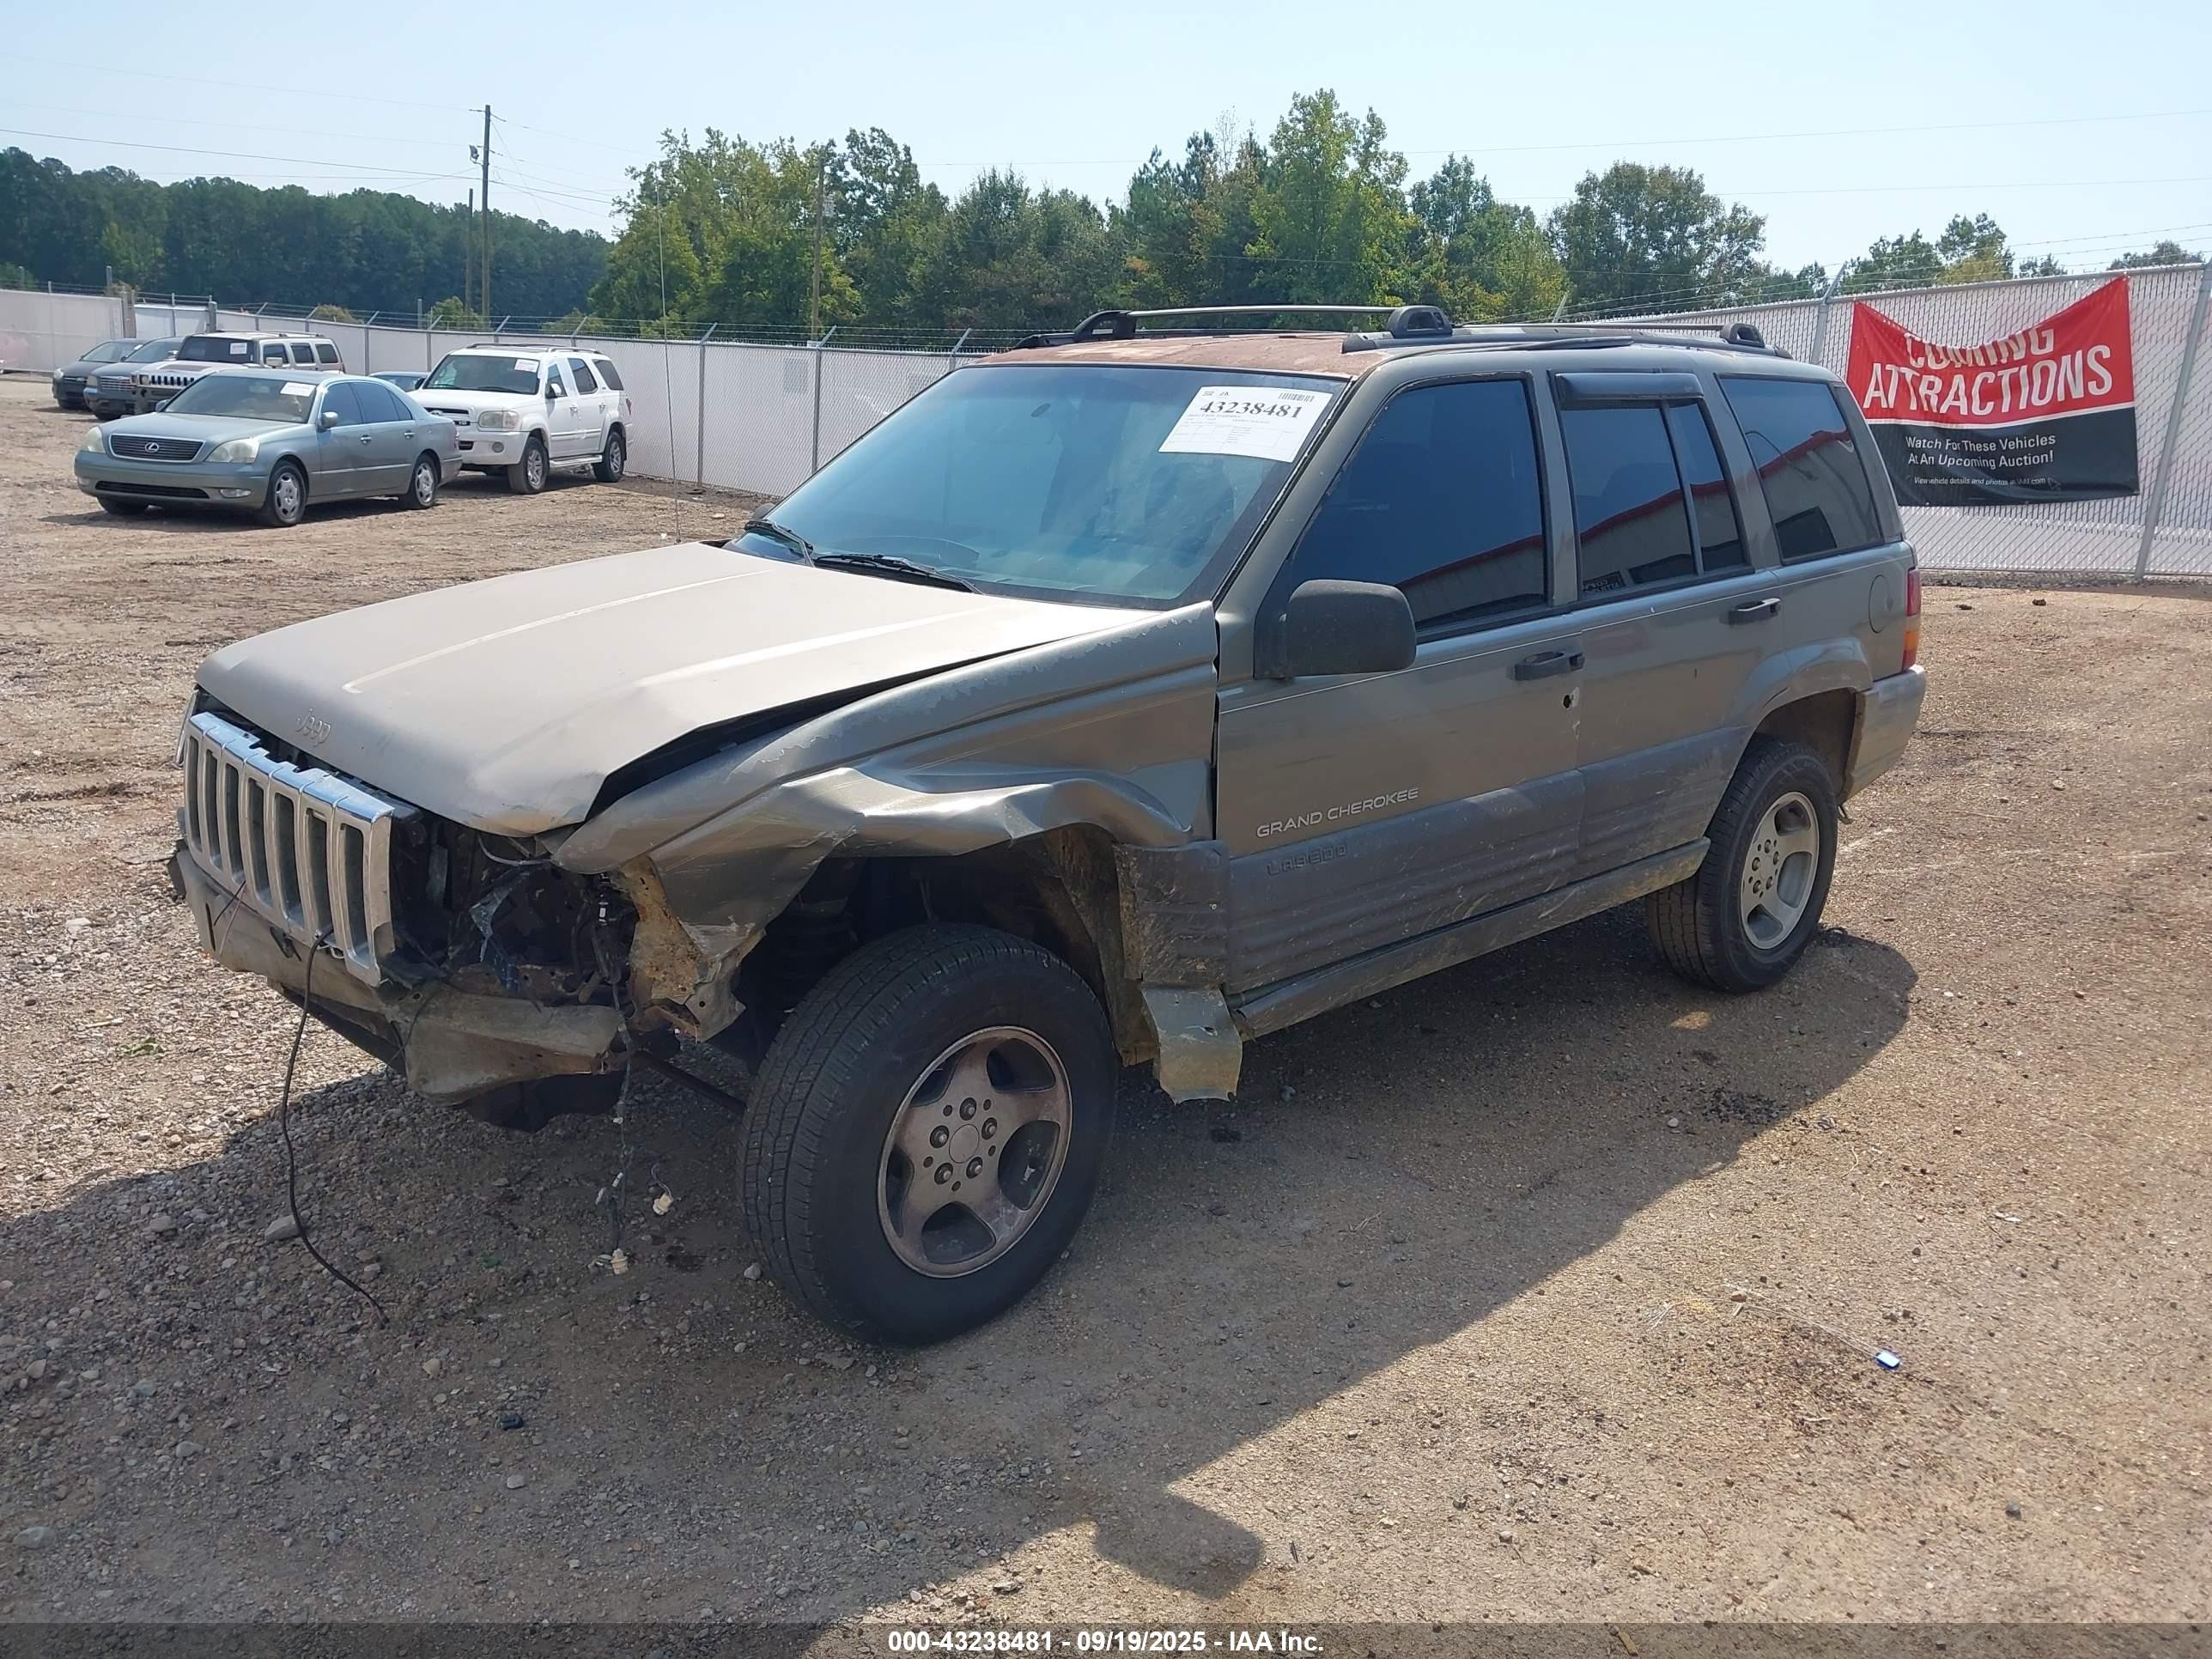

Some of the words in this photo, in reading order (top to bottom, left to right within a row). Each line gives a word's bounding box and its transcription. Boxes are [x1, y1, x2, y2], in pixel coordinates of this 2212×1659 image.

[1863, 344, 2112, 416] ATTRACTIONS
[1200, 400, 1304, 419] 43238481
[1905, 436, 1942, 450] Watch
[1945, 439, 1960, 451] For
[1961, 440, 1996, 453] These
[1999, 434, 2057, 450] Vehicles
[1908, 453, 1919, 465] At
[1920, 453, 1935, 465] An
[1938, 453, 1996, 470] Upcoming
[1999, 449, 2054, 467] Auction!
[1985, 477, 2008, 486] photos
[295, 708, 331, 748] Jeep
[1256, 811, 1323, 838] GRAND
[1327, 787, 1419, 821] CHEROKEE
[1267, 843, 1347, 876] LAREDO
